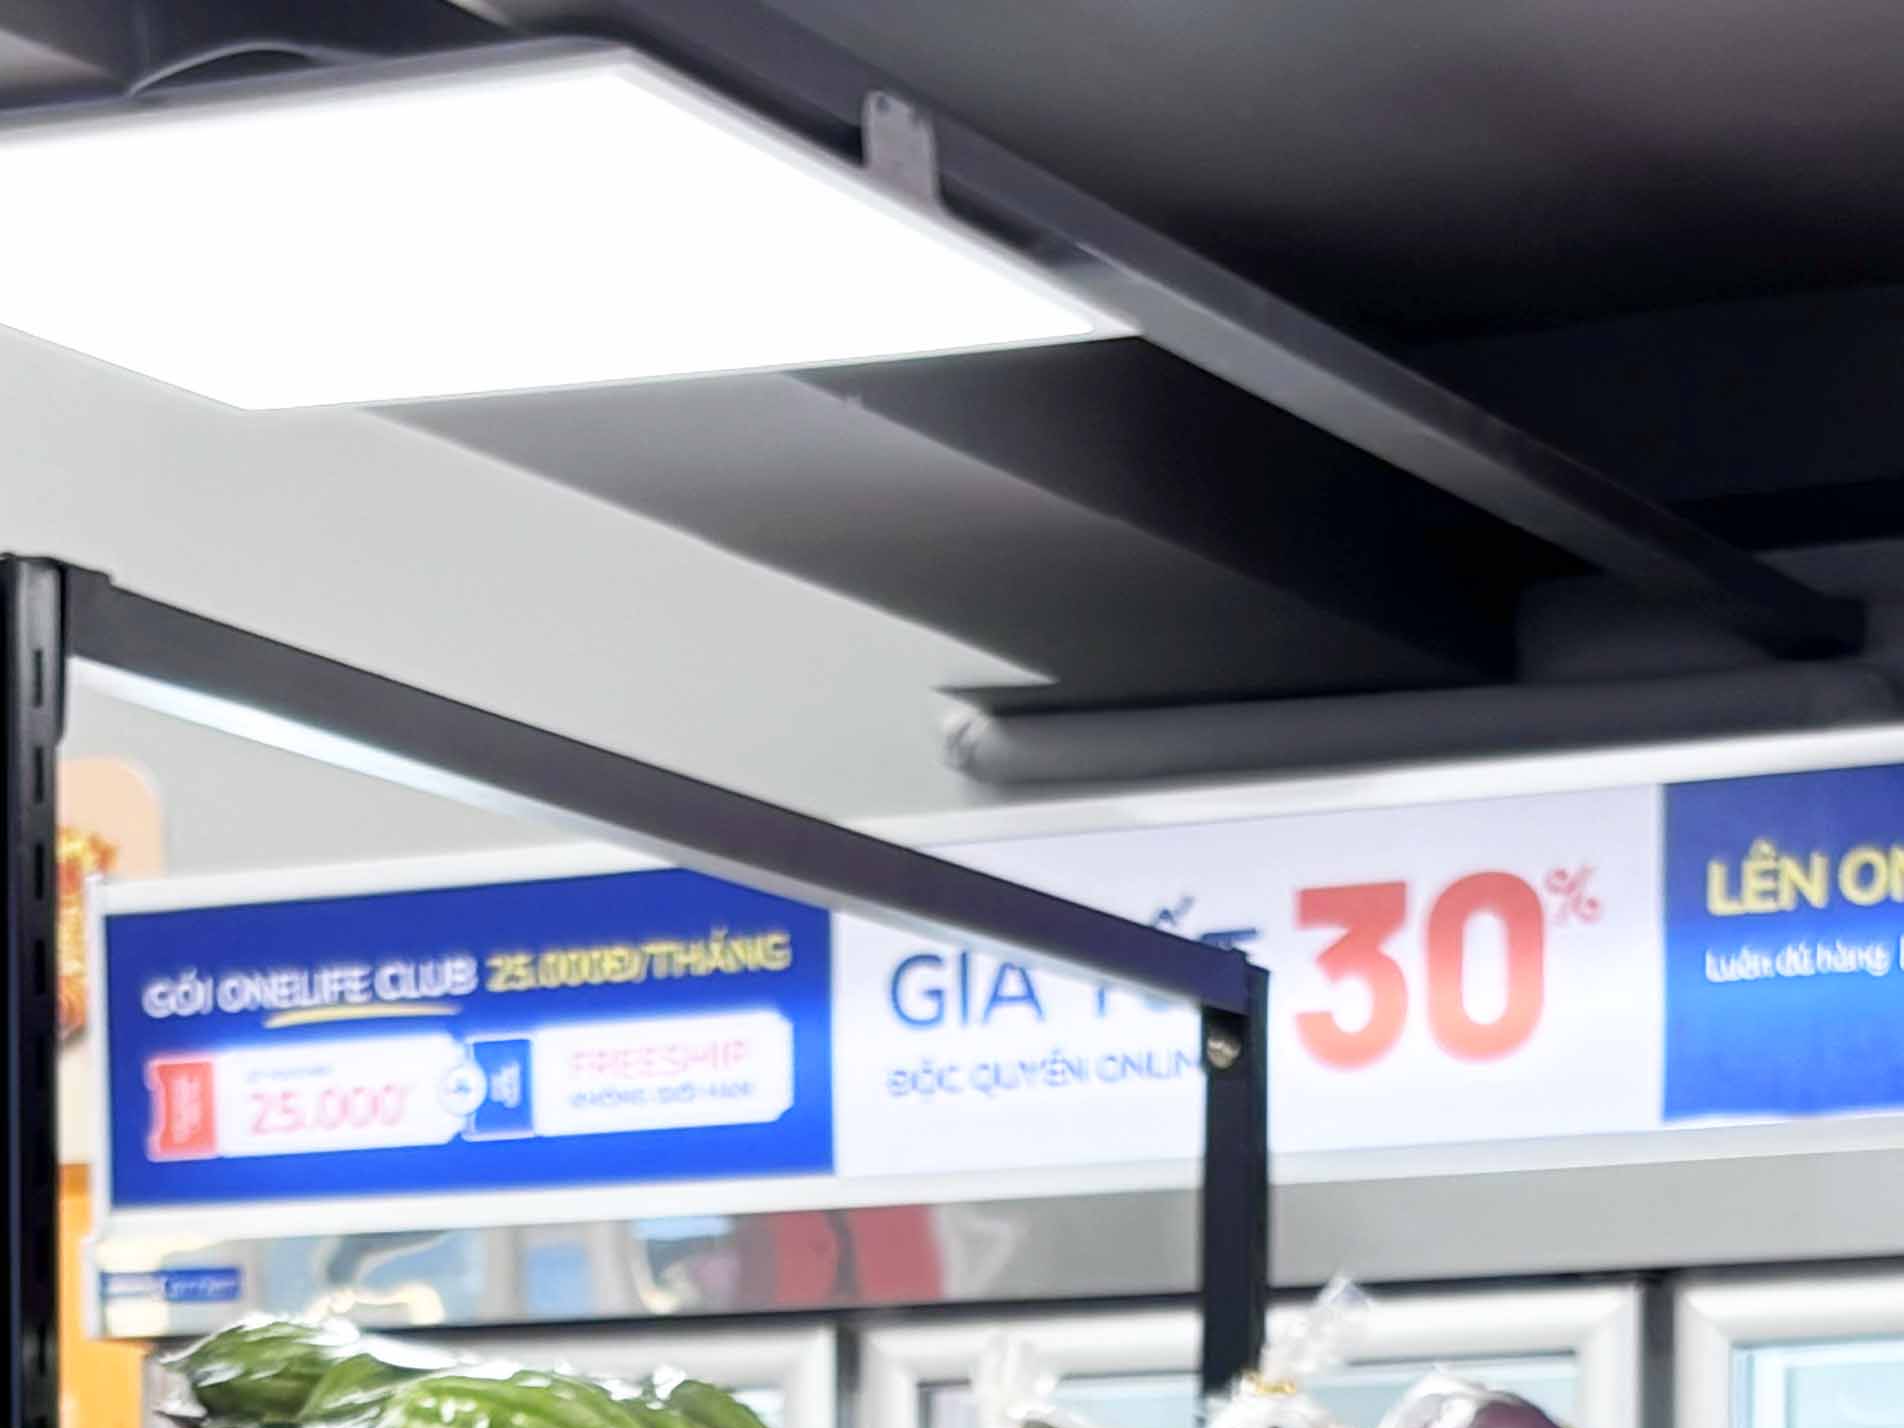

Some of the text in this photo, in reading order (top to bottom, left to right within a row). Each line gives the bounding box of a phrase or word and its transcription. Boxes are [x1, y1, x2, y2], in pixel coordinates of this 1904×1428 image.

[1706, 836, 1828, 915] LÊN
[142, 958, 213, 1016] GÓI
[220, 961, 372, 1012] ONELIFE
[374, 955, 476, 1000] CLUB
[1097, 1045, 1207, 1086] ONLIN
